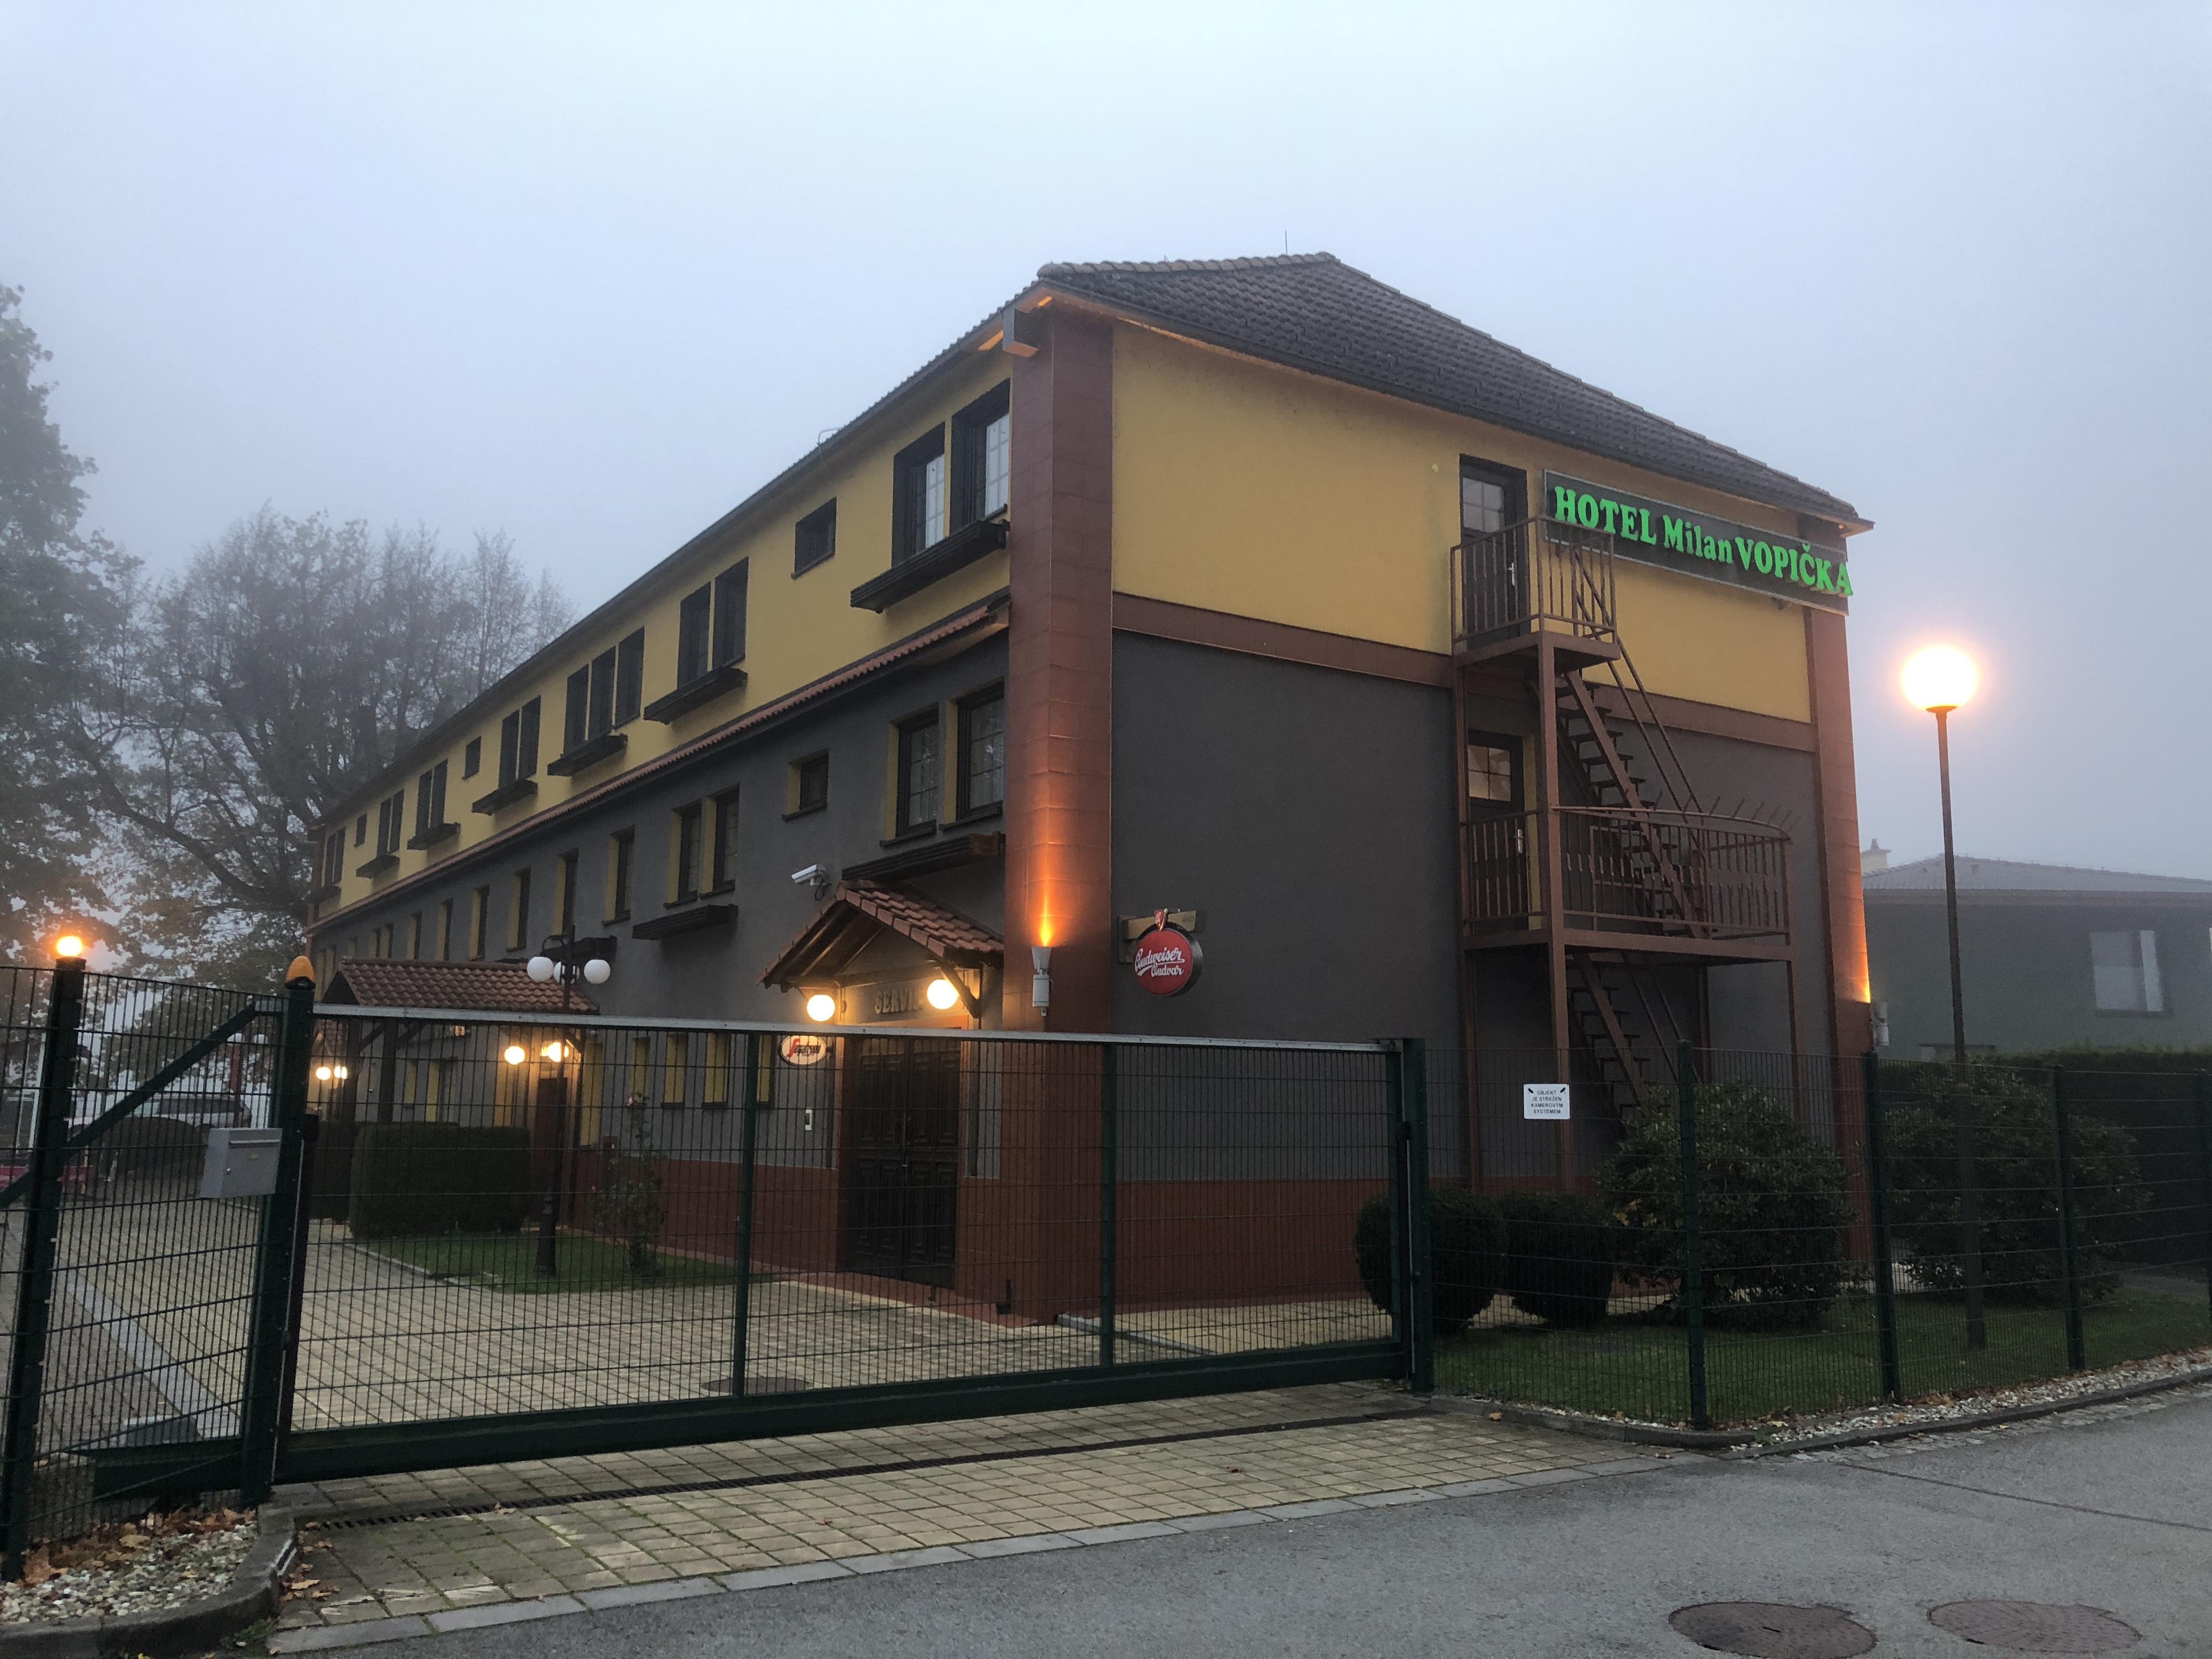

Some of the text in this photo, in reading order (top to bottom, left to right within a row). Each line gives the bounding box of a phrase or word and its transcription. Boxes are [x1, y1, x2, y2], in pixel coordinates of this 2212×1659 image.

[1554, 486, 1853, 596] HOTEL Milan VOPIČKA
[1135, 947, 1185, 975] Budweiser
